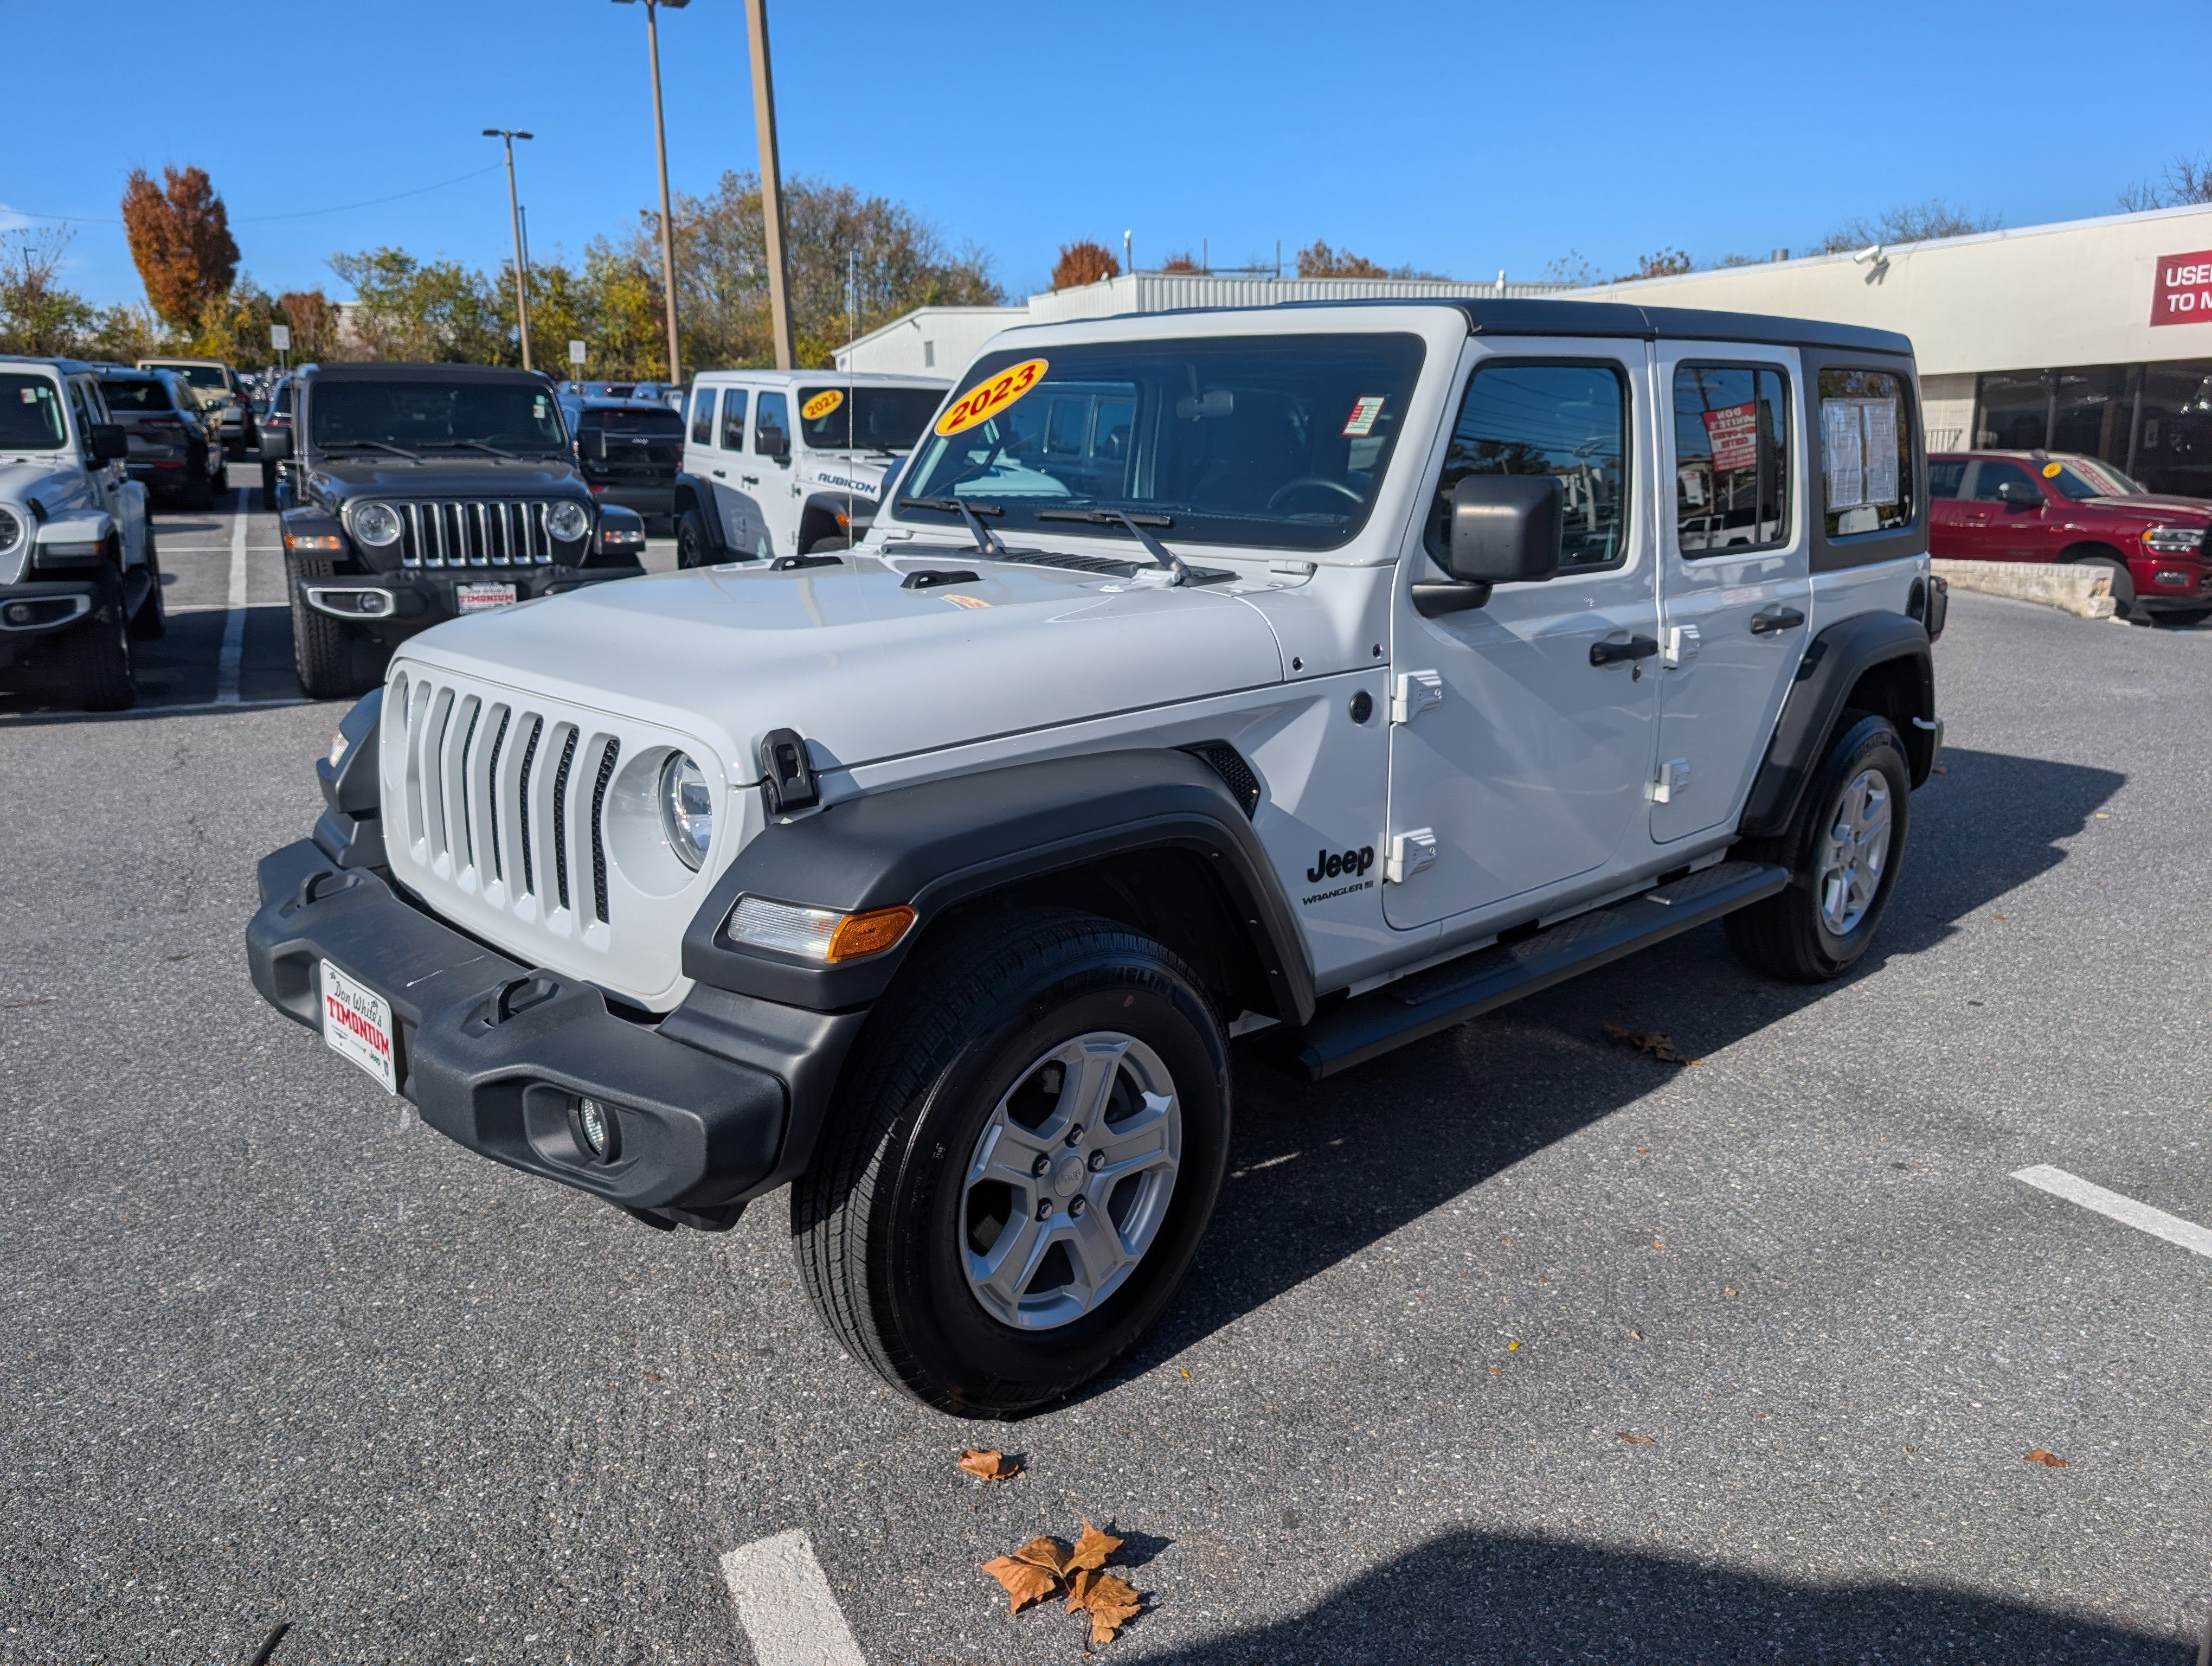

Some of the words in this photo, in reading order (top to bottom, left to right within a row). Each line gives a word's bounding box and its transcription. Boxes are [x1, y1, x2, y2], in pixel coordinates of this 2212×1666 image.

[2166, 264, 2212, 287] USE
[2167, 293, 2195, 312] TO
[807, 392, 839, 416] 2022
[947, 364, 1036, 431] 2023
[818, 473, 877, 494] RUBICON
[460, 594, 513, 603] TIMONIUM
[1307, 845, 1374, 883] Jeep
[1302, 883, 1362, 906] WRANGLER
[334, 981, 351, 1006] Don
[353, 992, 382, 1028] White's
[326, 994, 390, 1061] TIMONIUM
